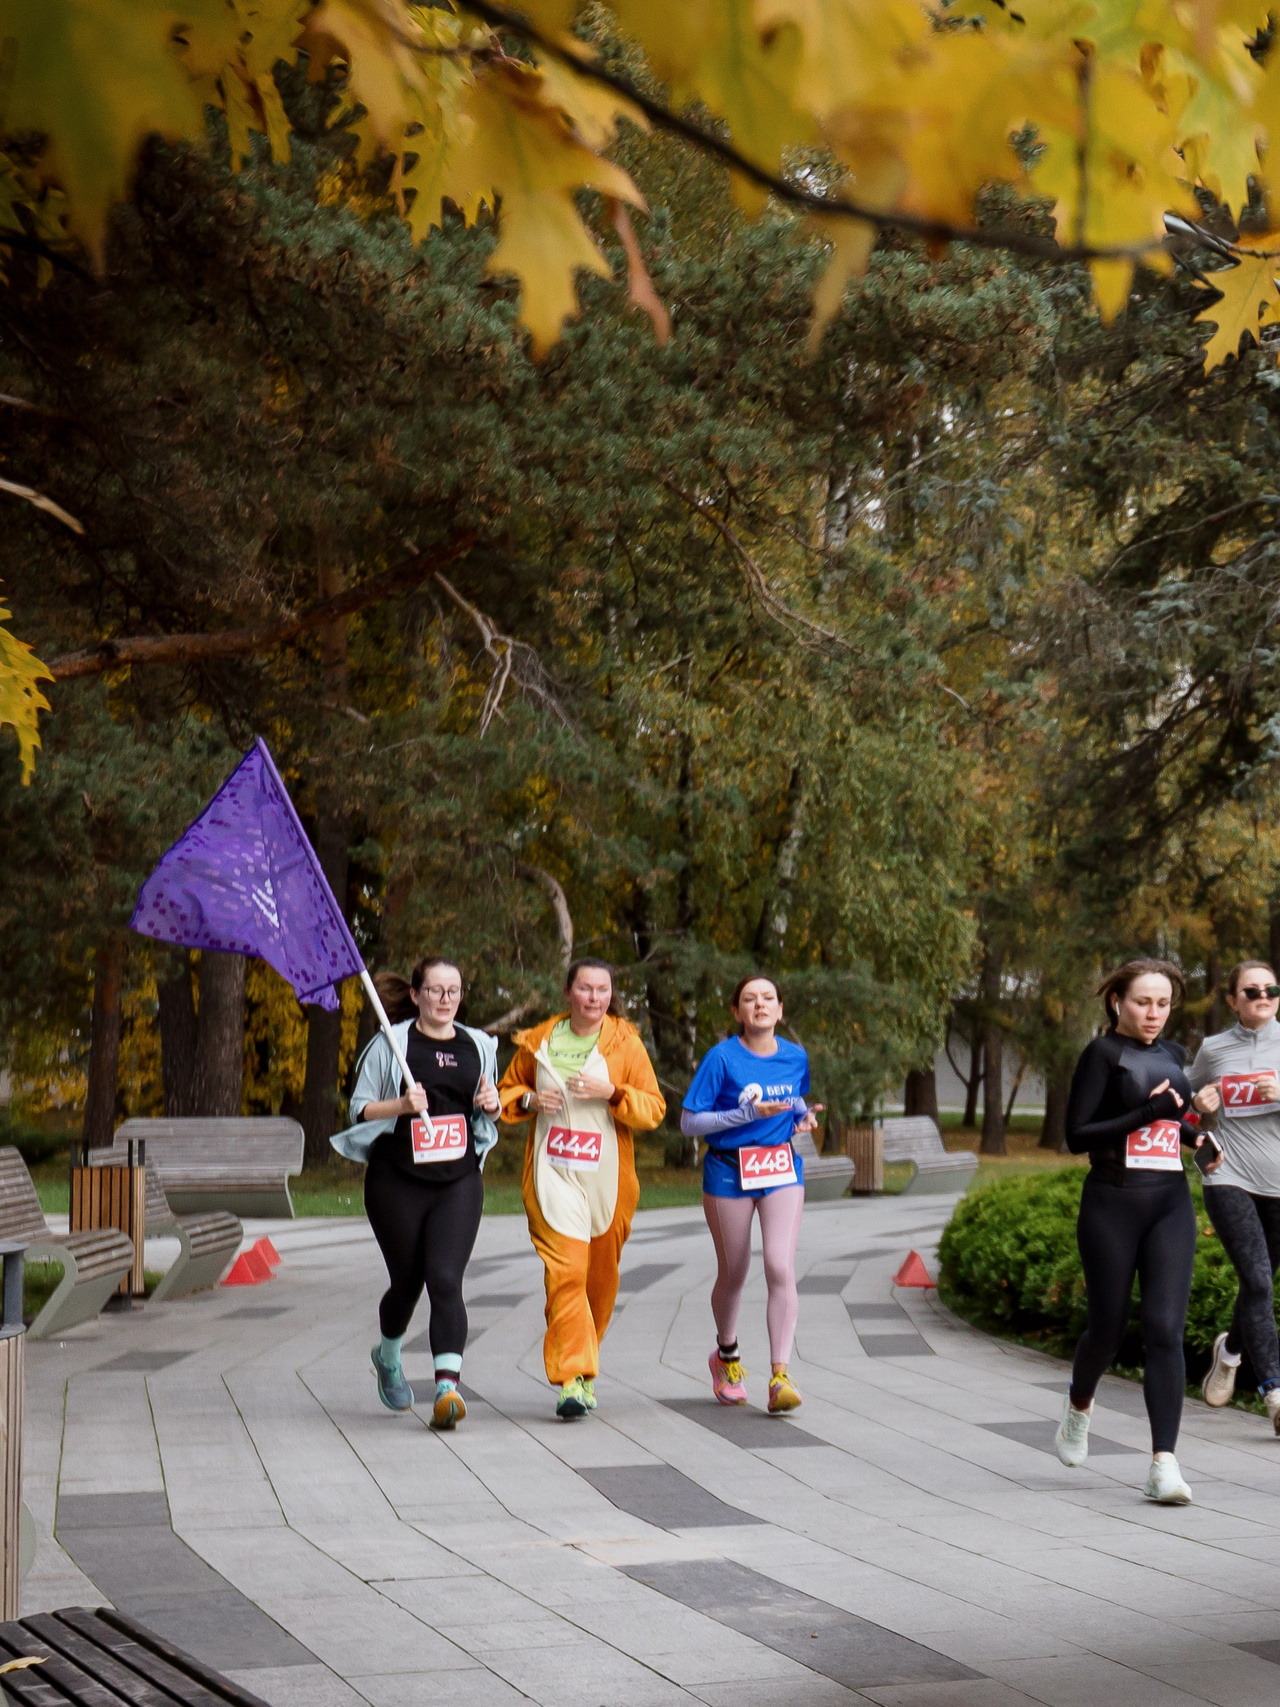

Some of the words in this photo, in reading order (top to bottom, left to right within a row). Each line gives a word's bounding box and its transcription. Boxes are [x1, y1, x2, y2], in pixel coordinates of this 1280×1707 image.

[1227, 1081, 1266, 1104] 27
[418, 1122, 462, 1149] 375
[549, 1132, 599, 1159] 444
[1134, 1127, 1177, 1153] 342
[745, 1149, 790, 1174] 448
